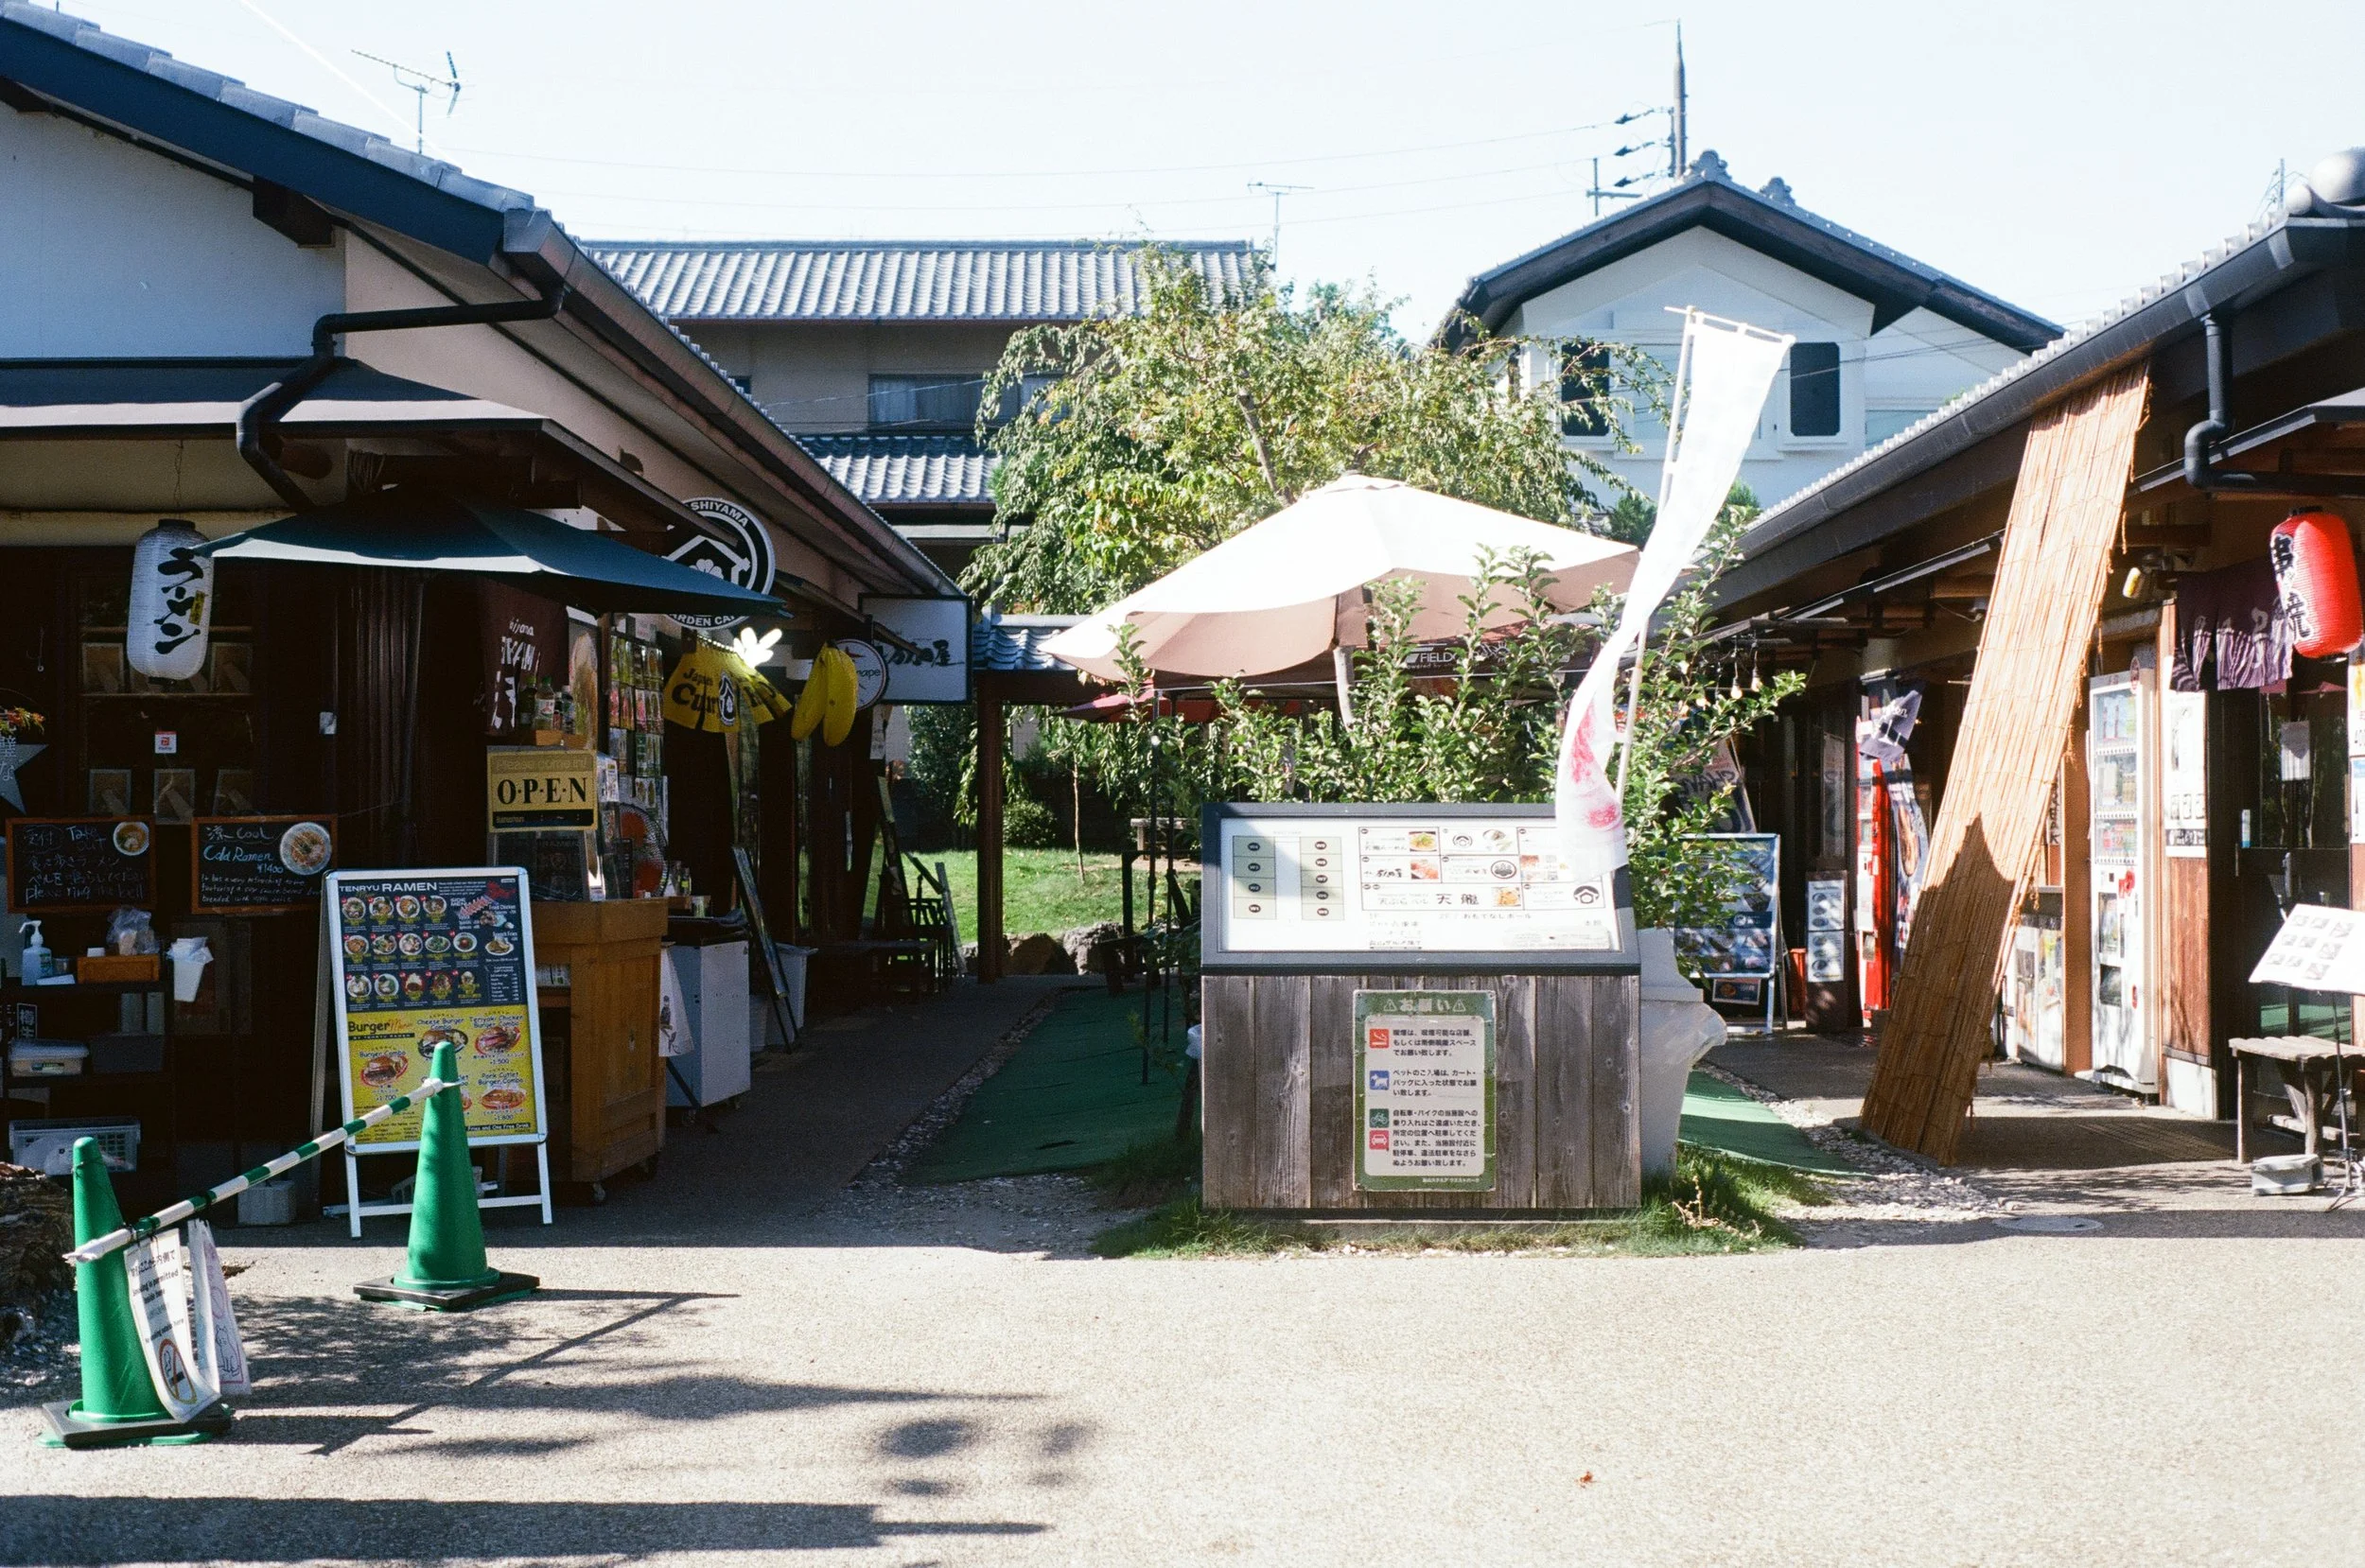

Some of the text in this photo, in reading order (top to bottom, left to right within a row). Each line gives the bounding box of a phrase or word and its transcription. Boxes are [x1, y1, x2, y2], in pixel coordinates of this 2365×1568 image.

[688, 500, 749, 527] SHIYAMA
[202, 844, 232, 862] Cold
[382, 882, 437, 892] RAMEN
[348, 1021, 390, 1034] Burger
[1393, 1049, 1452, 1057] でお願い致します。
